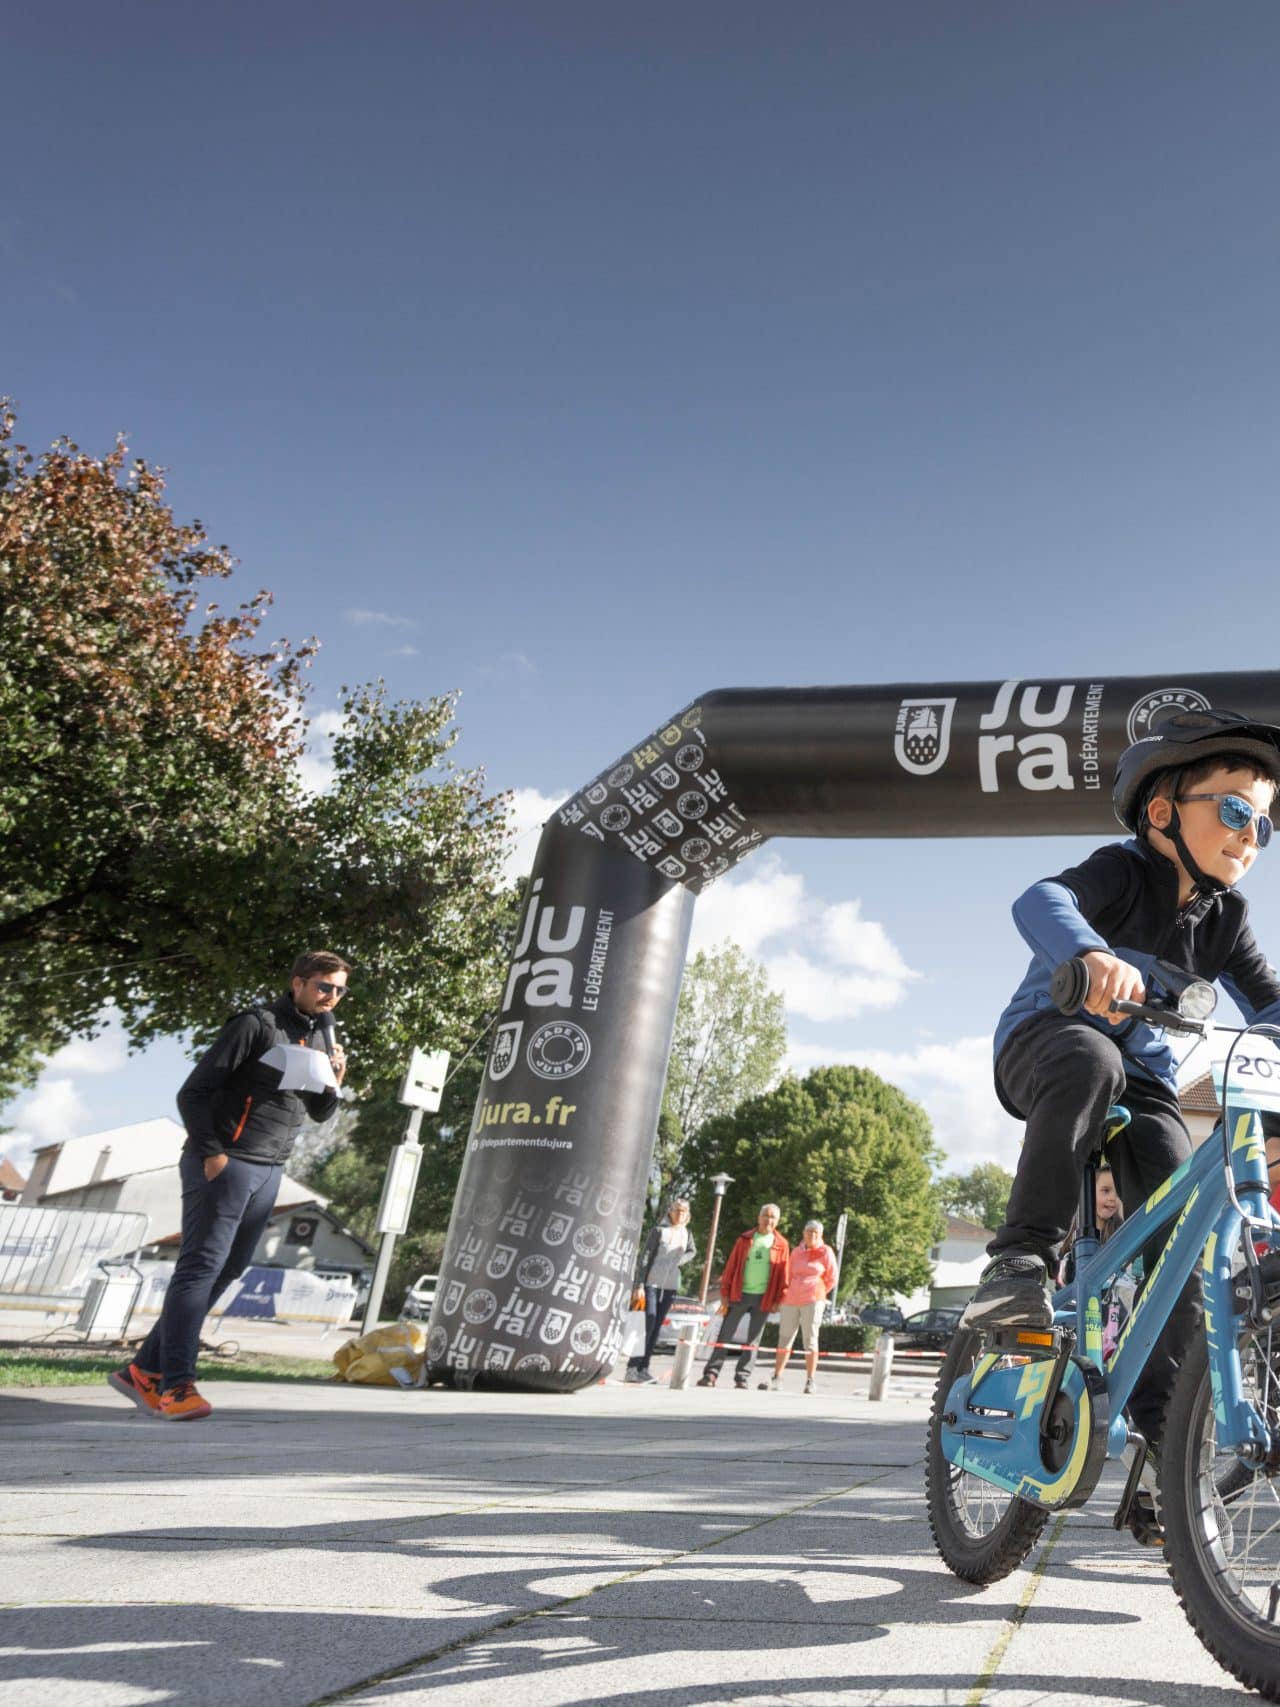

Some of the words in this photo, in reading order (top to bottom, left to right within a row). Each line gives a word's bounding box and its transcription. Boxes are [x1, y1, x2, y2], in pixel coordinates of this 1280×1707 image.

[1136, 694, 1187, 723] MADE
[1080, 684, 1105, 770] DÉPARTEMENT
[979, 733, 1076, 793] ra
[1085, 772, 1100, 790] LE
[514, 878, 586, 958] ju
[585, 909, 615, 995] DÉPARTEMENT
[502, 958, 573, 1012] ra
[582, 996, 598, 1012] LE
[534, 1026, 573, 1049] MADE
[574, 1035, 584, 1052] IN
[536, 1059, 574, 1074] JURA
[476, 1096, 577, 1135] jura.fr
[501, 1286, 534, 1318] ju
[551, 1280, 581, 1304] ra
[493, 1313, 525, 1337] ra
